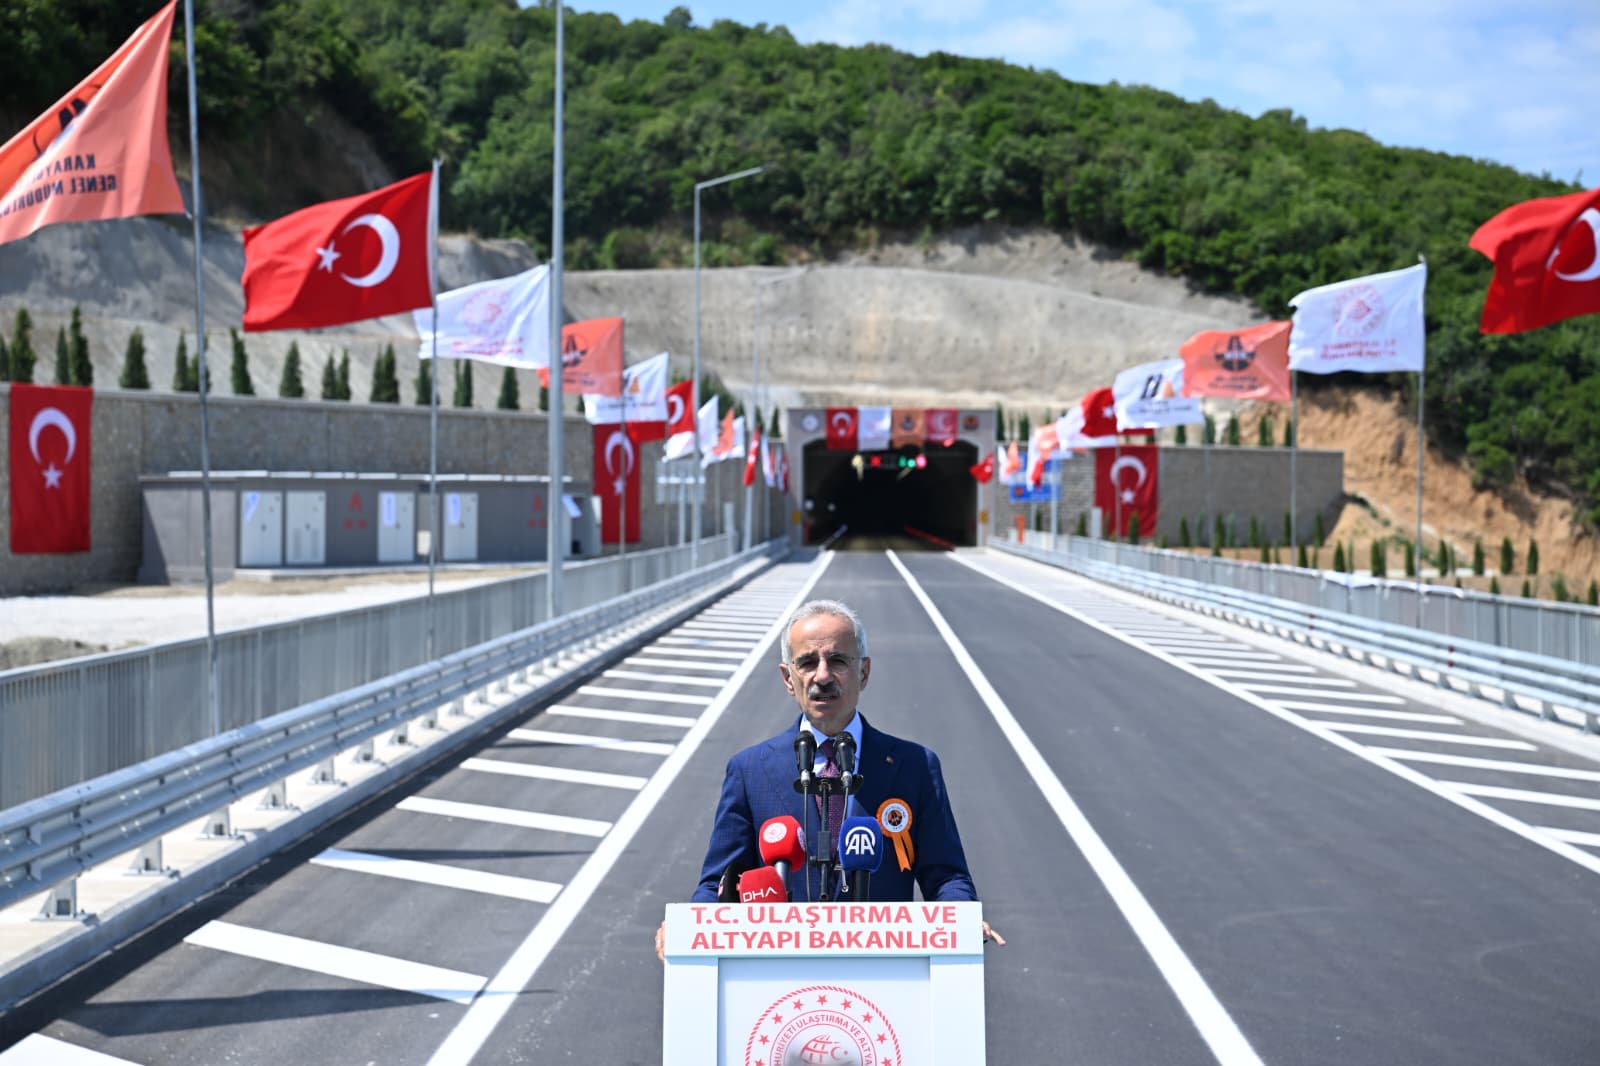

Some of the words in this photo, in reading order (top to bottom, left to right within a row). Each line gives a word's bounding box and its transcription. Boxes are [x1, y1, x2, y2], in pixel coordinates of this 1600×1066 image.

[845, 830, 876, 856] AA
[742, 886, 778, 903] DHA
[691, 906, 739, 925] T.C.
[747, 905, 913, 928] ULAŞTIRMA
[921, 905, 957, 924] VE
[691, 931, 801, 950] ALTYAPI
[808, 927, 957, 950] BAKANLIĞI
[796, 1014, 849, 1029] ULAŞTIRMA
[850, 1024, 862, 1037] VE
